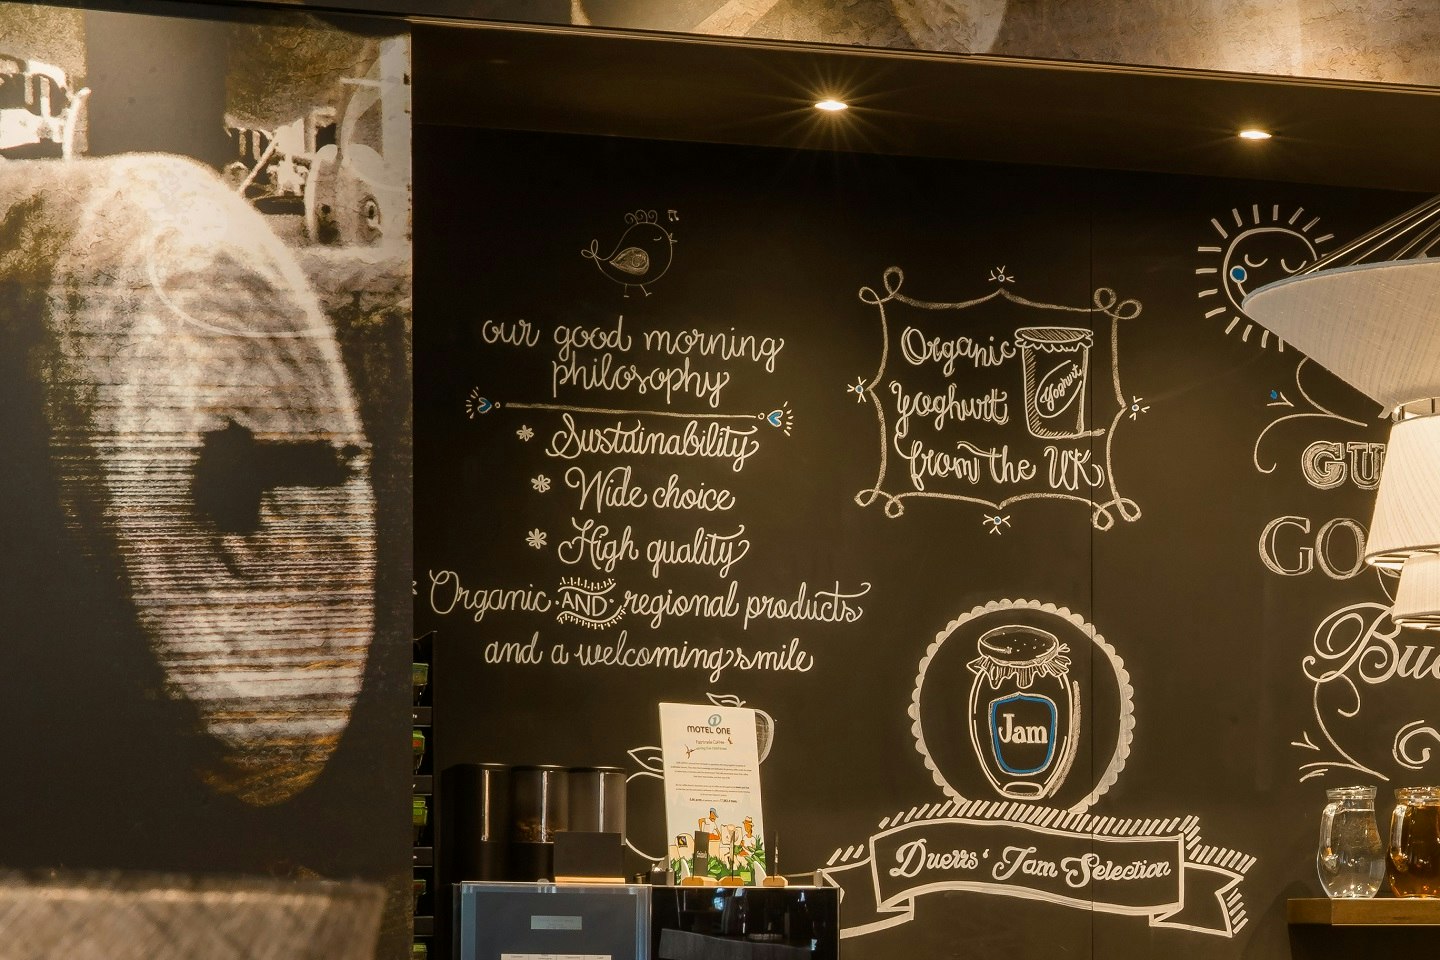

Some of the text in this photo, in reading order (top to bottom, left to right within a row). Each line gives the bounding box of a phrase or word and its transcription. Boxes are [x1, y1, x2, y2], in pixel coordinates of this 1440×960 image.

[482, 315, 785, 373] our good morning
[901, 326, 1016, 377] Organic
[552, 351, 730, 407] philosophy
[546, 413, 760, 472] Sustainability
[894, 440, 1104, 491] from the UK
[565, 466, 736, 514] Wide choice
[558, 517, 750, 578] High quality
[429, 570, 872, 630] Organic AND regional products
[484, 630, 814, 682] and a welcoming smile
[687, 725, 731, 735] MOTEL ONE
[999, 713, 1048, 745] Jam
[992, 846, 1058, 881] Jam
[1061, 853, 1171, 888] Selection
